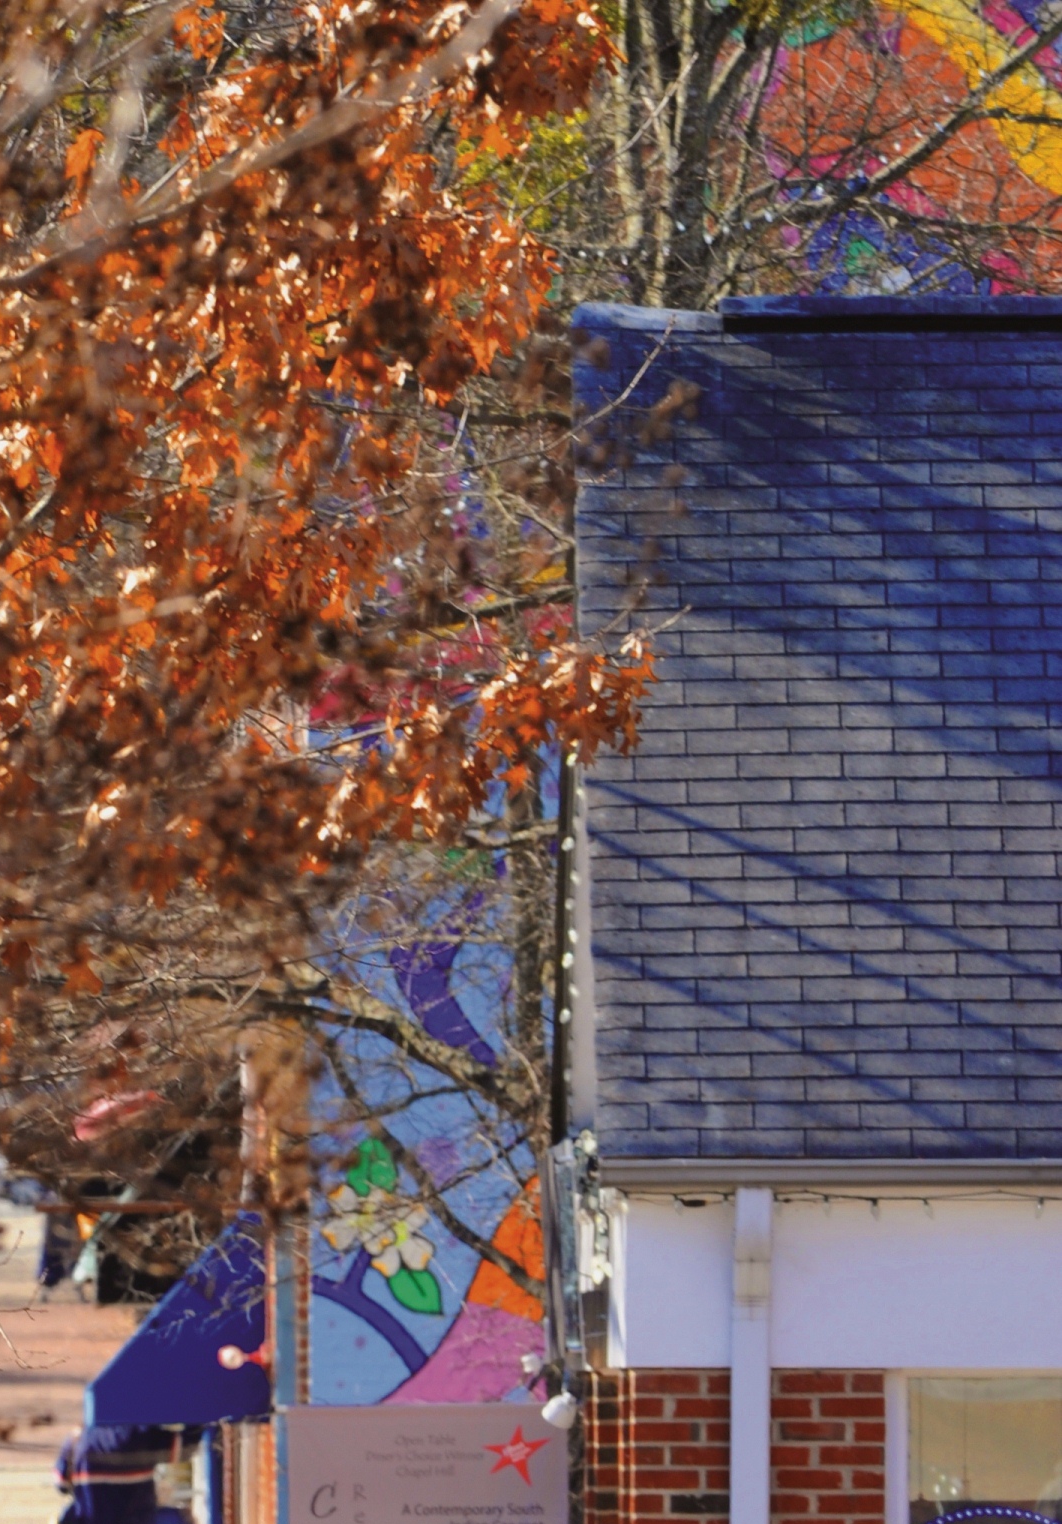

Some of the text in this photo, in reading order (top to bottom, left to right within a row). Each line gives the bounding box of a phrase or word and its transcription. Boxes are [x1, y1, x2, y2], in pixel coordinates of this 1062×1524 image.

[395, 1463, 455, 1478] Chapel Hill
[402, 1502, 544, 1519] A Contemporary South
